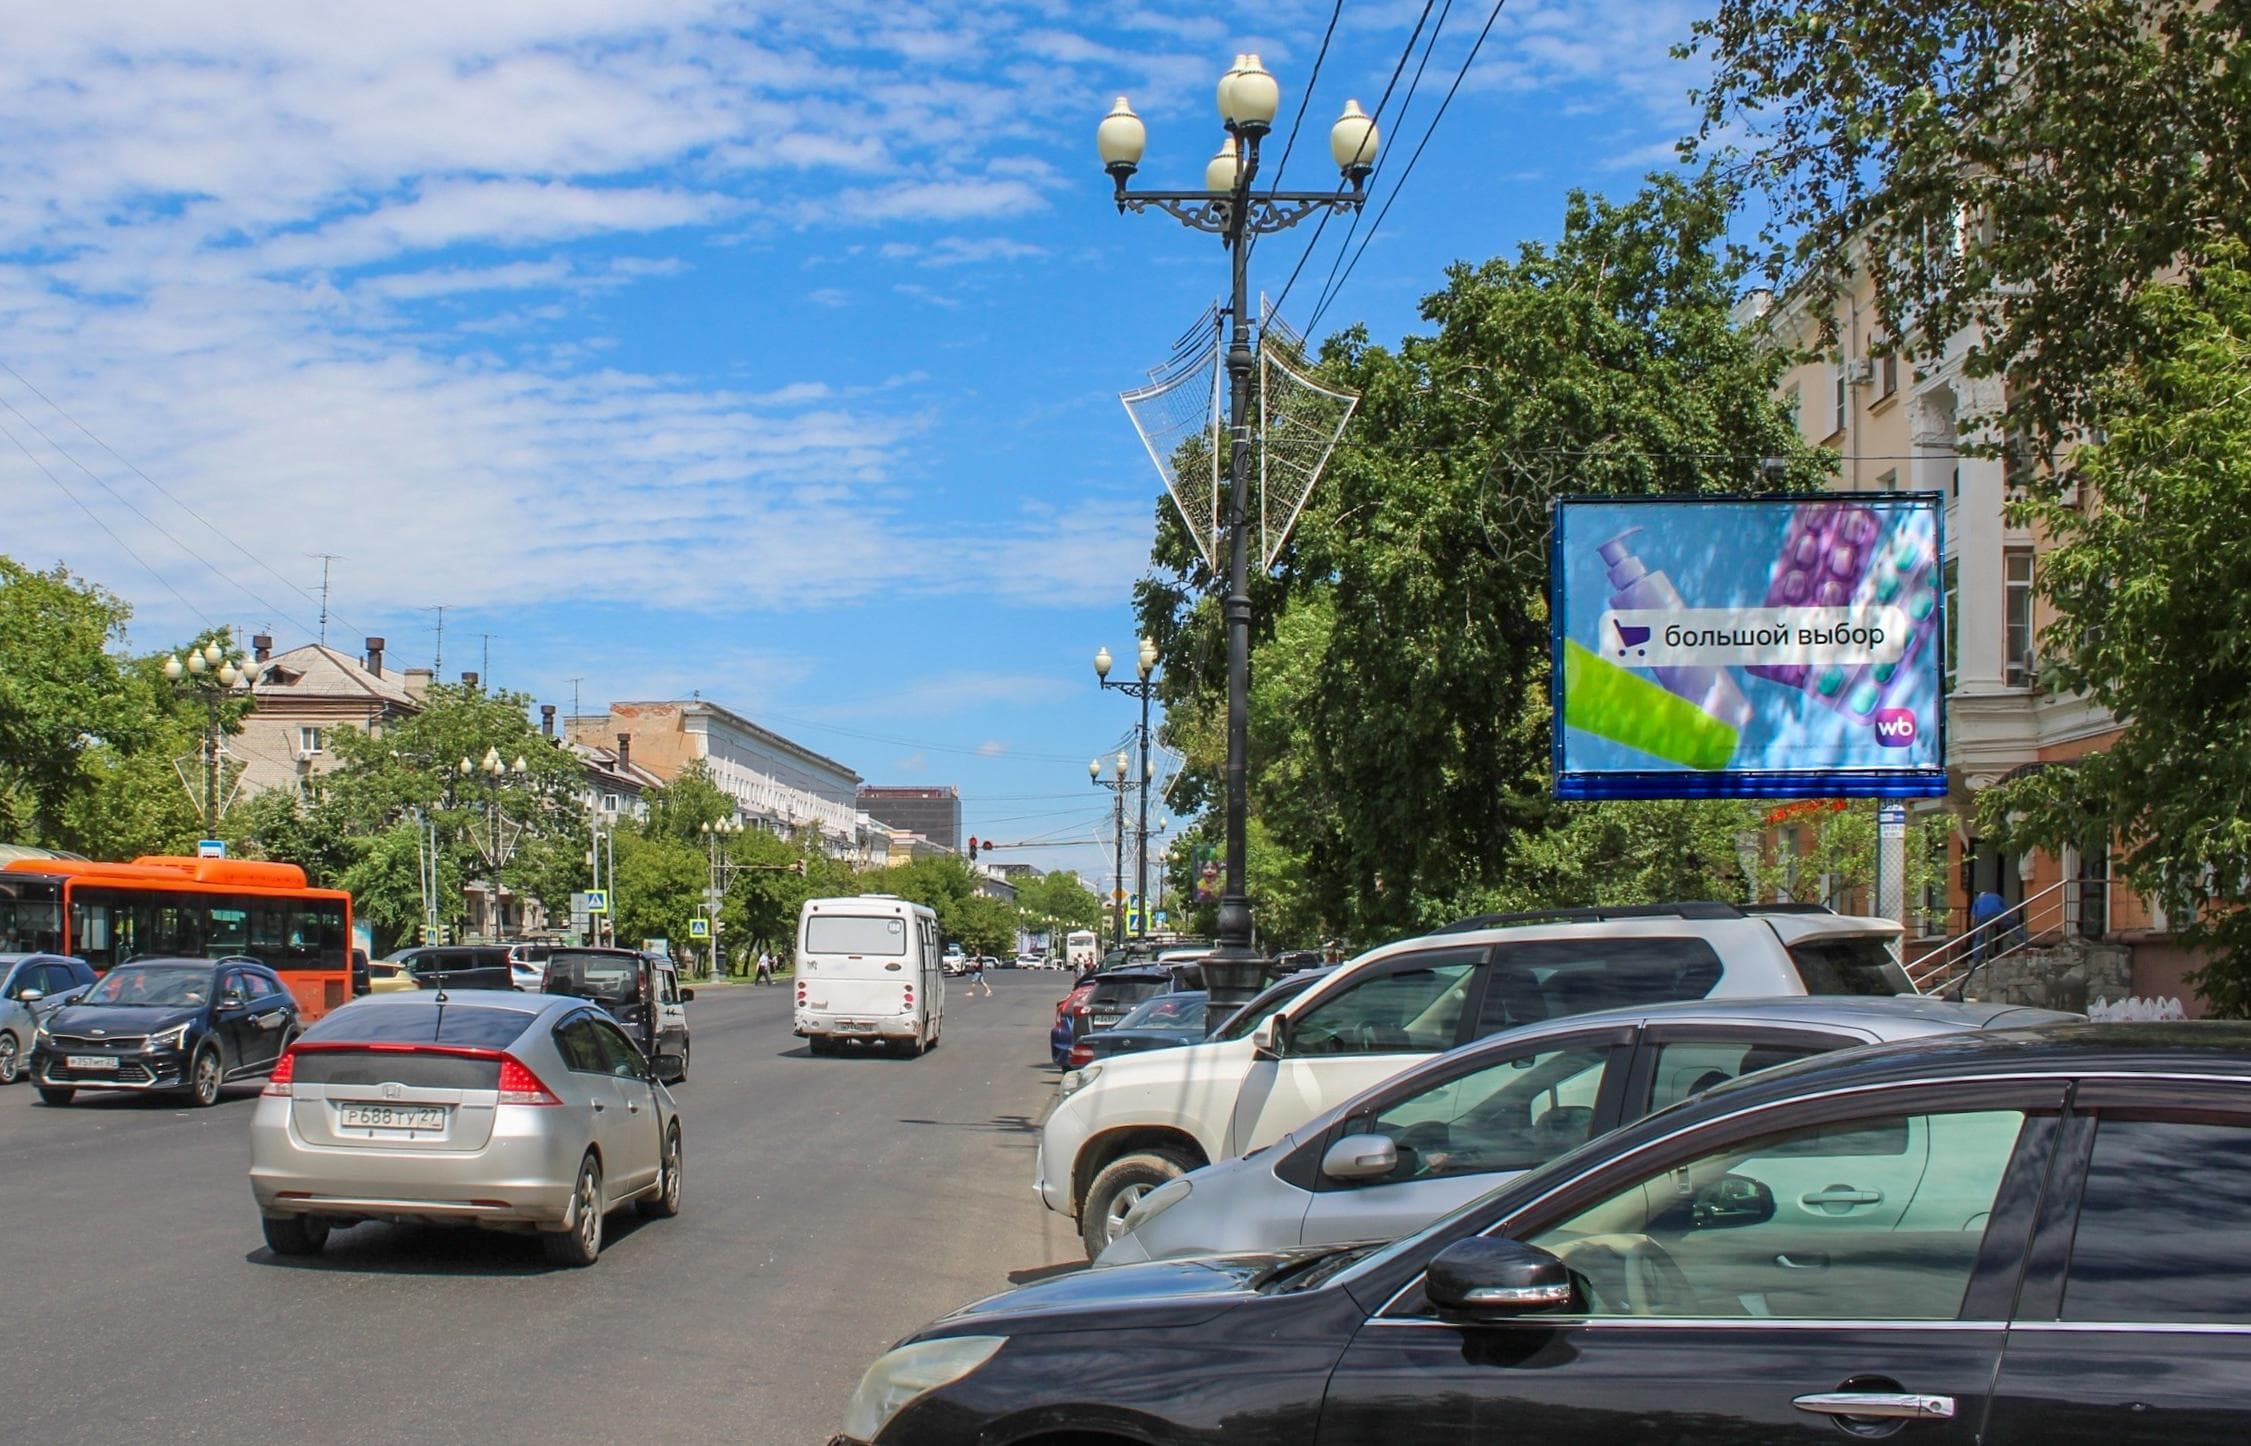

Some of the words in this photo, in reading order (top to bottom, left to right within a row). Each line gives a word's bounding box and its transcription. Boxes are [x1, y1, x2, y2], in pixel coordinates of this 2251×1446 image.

[1665, 623, 1788, 647] большой
[1798, 622, 1885, 649] выбор
[1877, 716, 1913, 736] wb
[348, 1107, 416, 1125] Р688ТУ
[421, 1109, 438, 1122] 27
